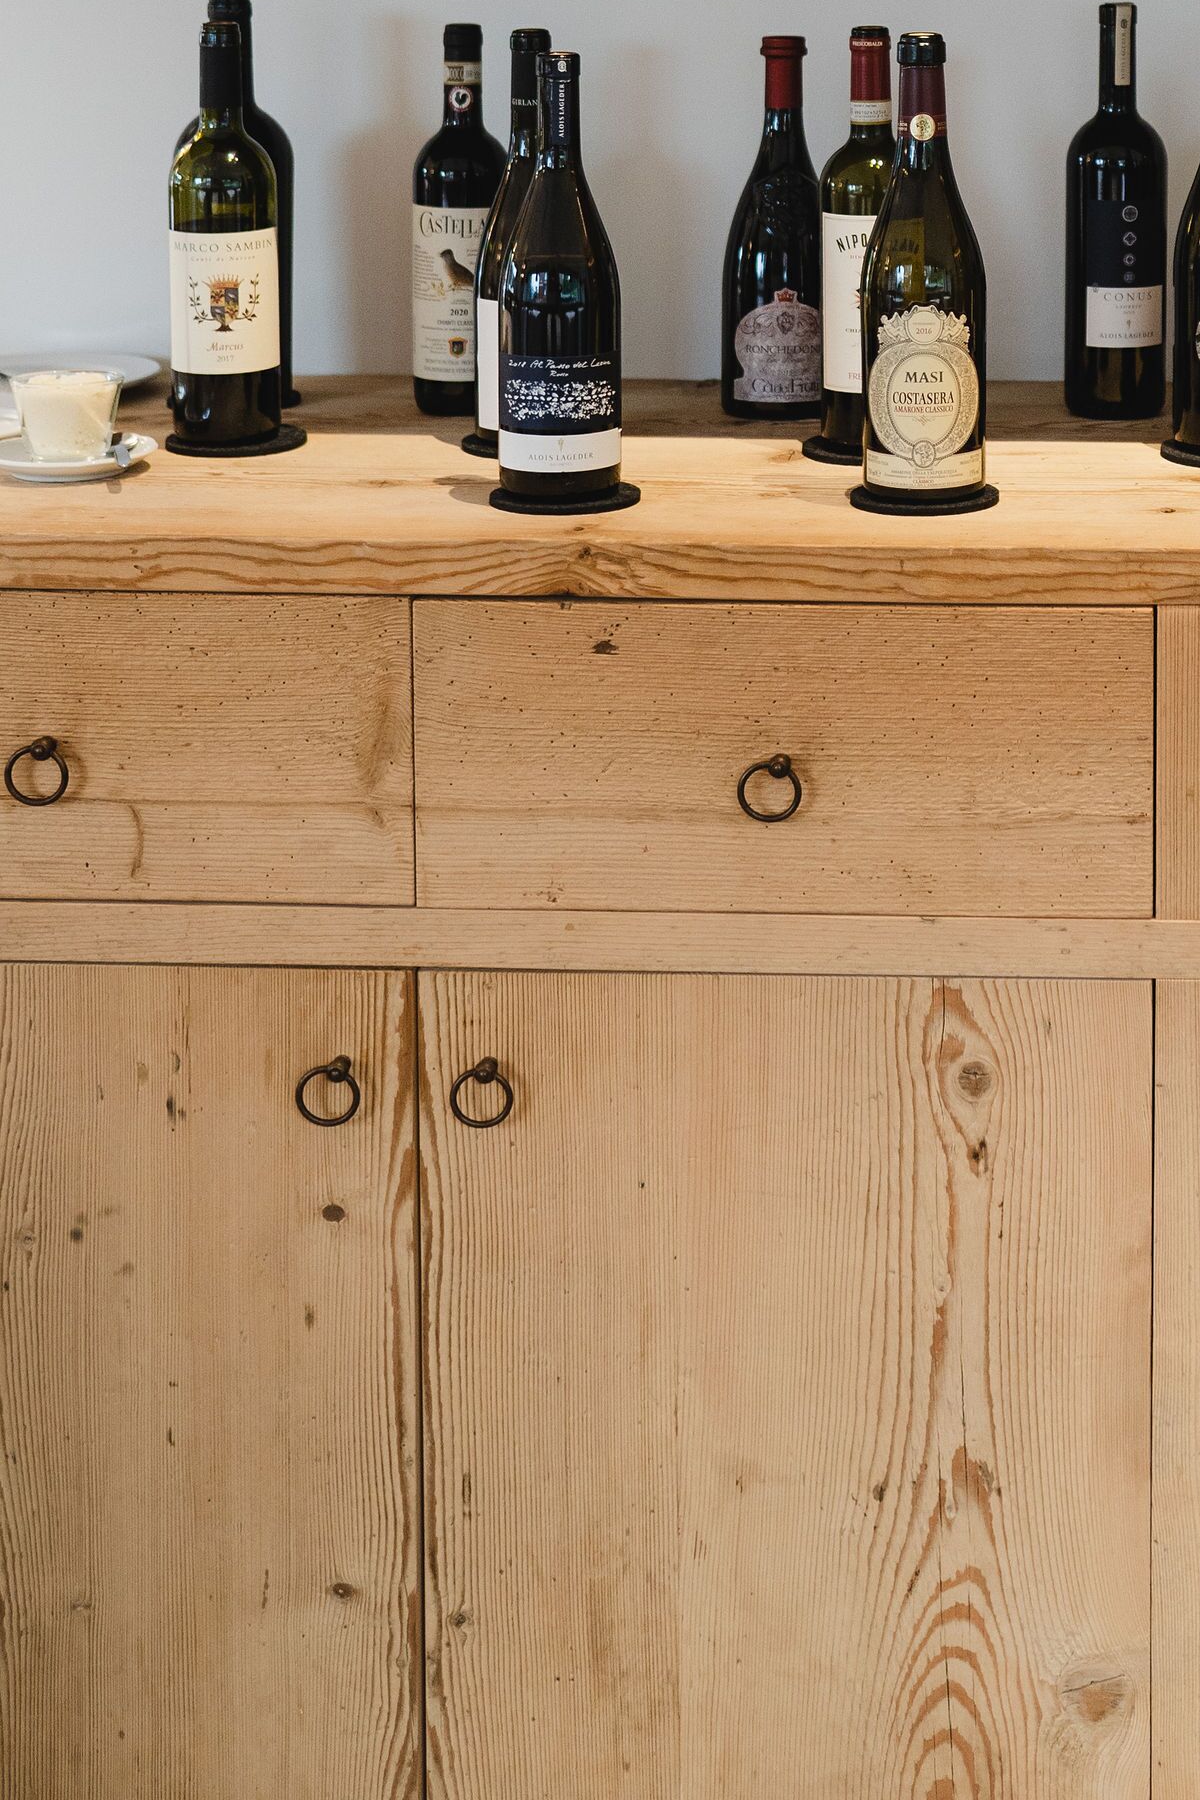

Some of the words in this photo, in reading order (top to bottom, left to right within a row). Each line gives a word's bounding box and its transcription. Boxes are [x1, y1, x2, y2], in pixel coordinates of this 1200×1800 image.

[512, 97, 538, 107] GIRLAN
[558, 83, 566, 115] LAGEDER
[558, 116, 566, 138] ALOIS
[174, 241, 219, 253] MARCO
[226, 239, 273, 252] SAMBIN
[1103, 292, 1152, 302] CONUS
[450, 308, 469, 317] 2020
[916, 327, 933, 335] 2016
[206, 341, 244, 352] Marcus
[216, 355, 235, 363] 2017
[904, 371, 944, 383] MASI
[892, 391, 954, 405] COSTASERA
[894, 405, 923, 413] AMARONE
[924, 405, 954, 413] CLASSICO
[528, 453, 554, 461] ALOIS
[556, 452, 594, 461] LAGEDER
